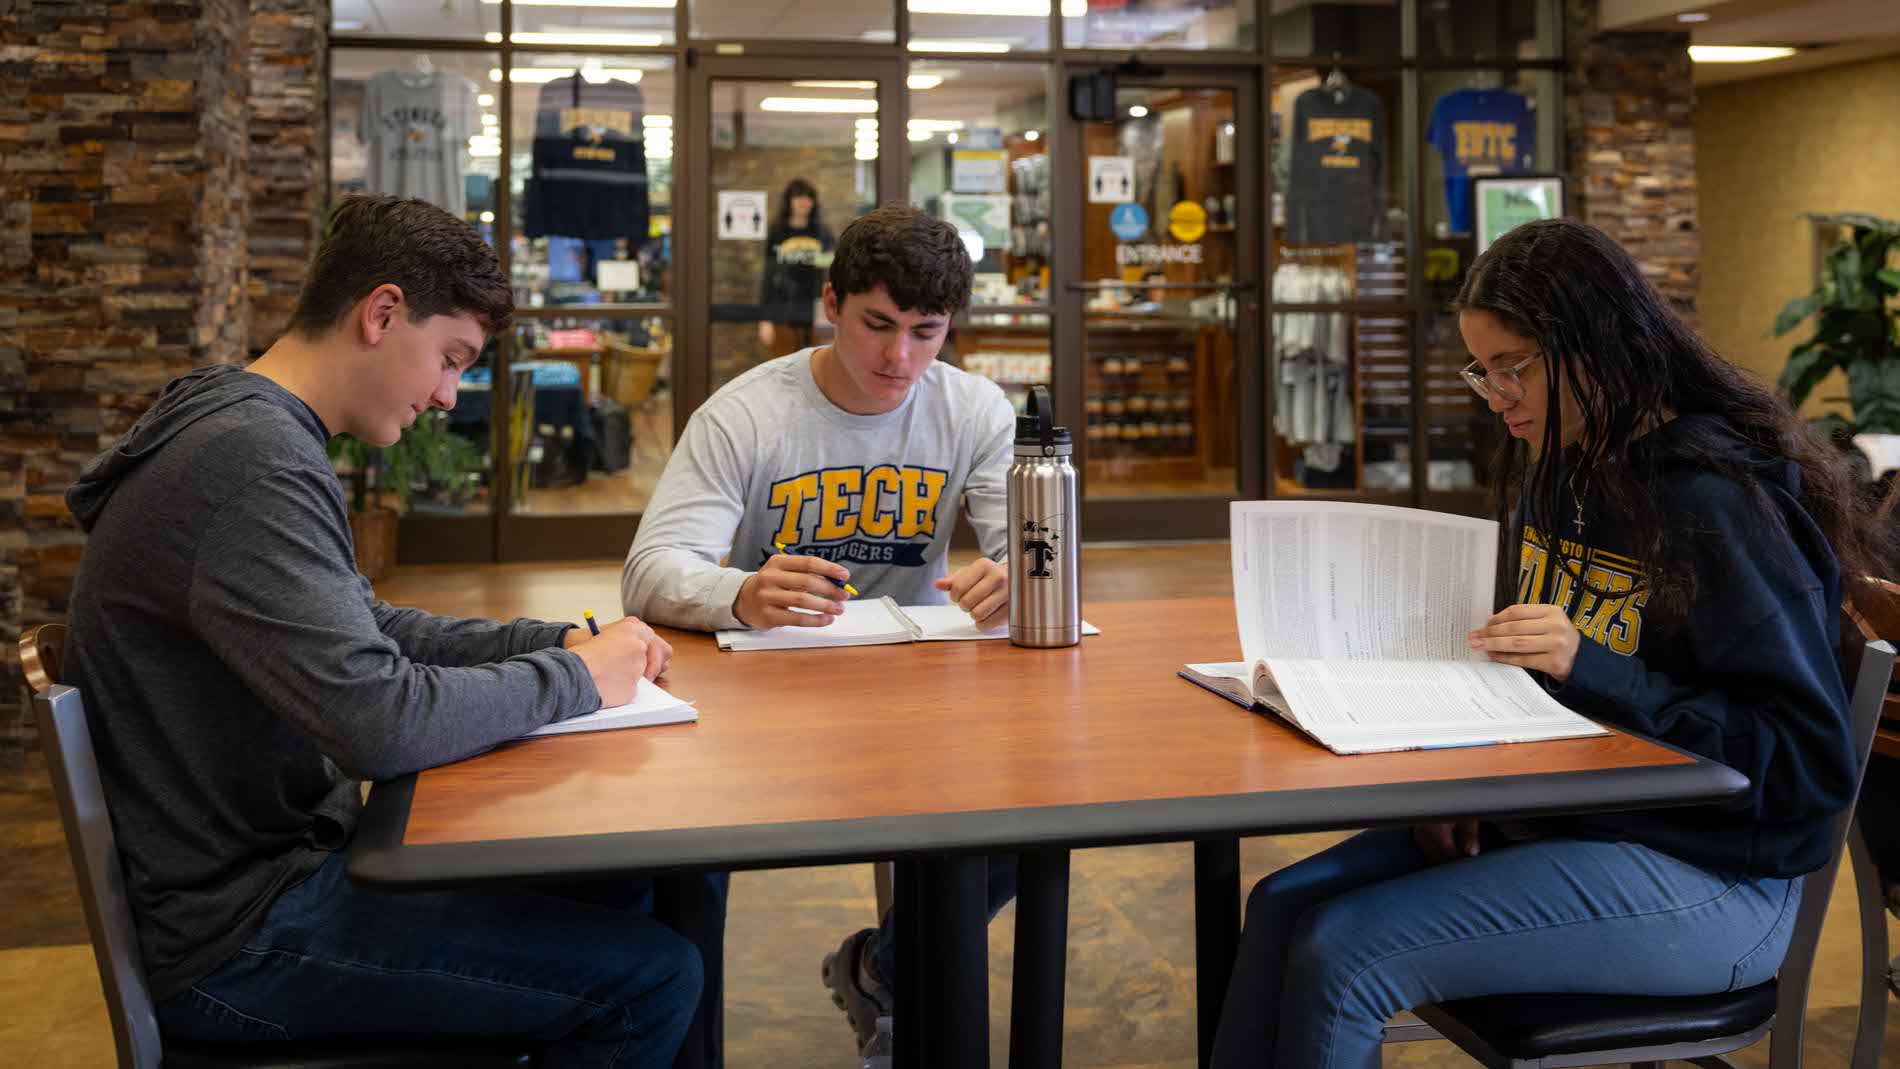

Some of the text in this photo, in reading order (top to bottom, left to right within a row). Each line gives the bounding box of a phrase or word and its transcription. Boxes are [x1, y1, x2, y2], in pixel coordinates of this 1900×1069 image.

[1116, 243, 1203, 265] ENTRANCE
[767, 464, 949, 546] TECH
[804, 541, 894, 562] STINGERS
